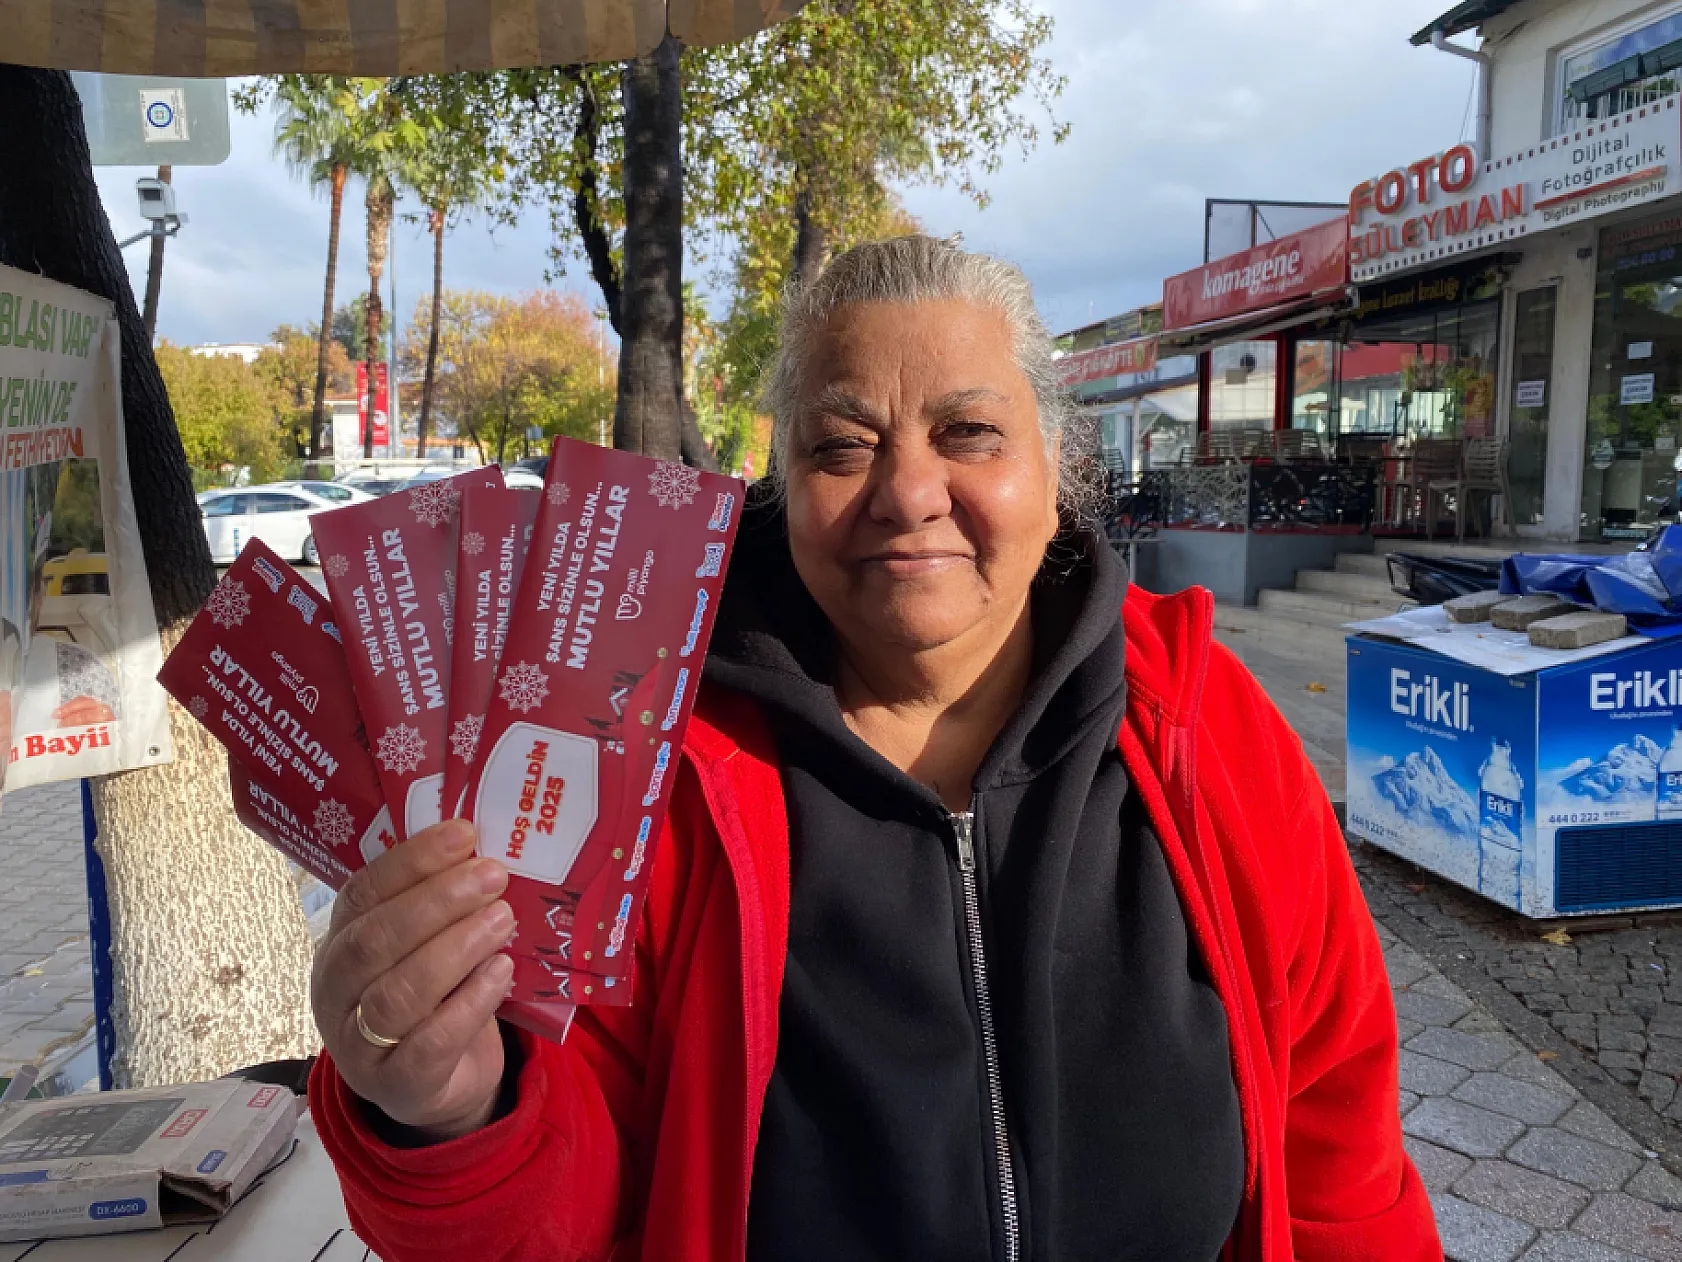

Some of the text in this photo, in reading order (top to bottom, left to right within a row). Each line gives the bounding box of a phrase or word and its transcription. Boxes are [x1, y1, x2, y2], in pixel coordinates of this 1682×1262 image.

[1349, 144, 1473, 226] FOTO
[1542, 143, 1666, 194] Fotoğrafçılık
[1573, 132, 1629, 164] Dijital
[1349, 183, 1524, 264] SÜLEYMAN
[1543, 179, 1666, 222] Digital Photography
[498, 524, 516, 594] OLSUN...
[537, 522, 571, 611] YENİ YILDA
[546, 482, 603, 663] ŞANS SİZİNLE OLSUN...
[566, 485, 630, 670] MUTLU YILLAR
[352, 585, 385, 677] YENİ YILDA
[363, 535, 420, 715] ŞANS SİZİNLE OLSUN...
[382, 528, 445, 709] MUTLU YILLAR
[472, 570, 492, 661] YENİ YILDA
[202, 665, 325, 792] ŞANS SİZİNLE OLSUN...
[209, 644, 339, 777] MUTLU YILLAR
[1391, 667, 1470, 731] Erikli
[1590, 669, 1682, 711] Erikli
[24, 726, 111, 759] Bayii
[222, 709, 282, 777] YENİ YILDA
[506, 740, 549, 859] HOŞ GELDİN
[535, 776, 565, 835] 2025
